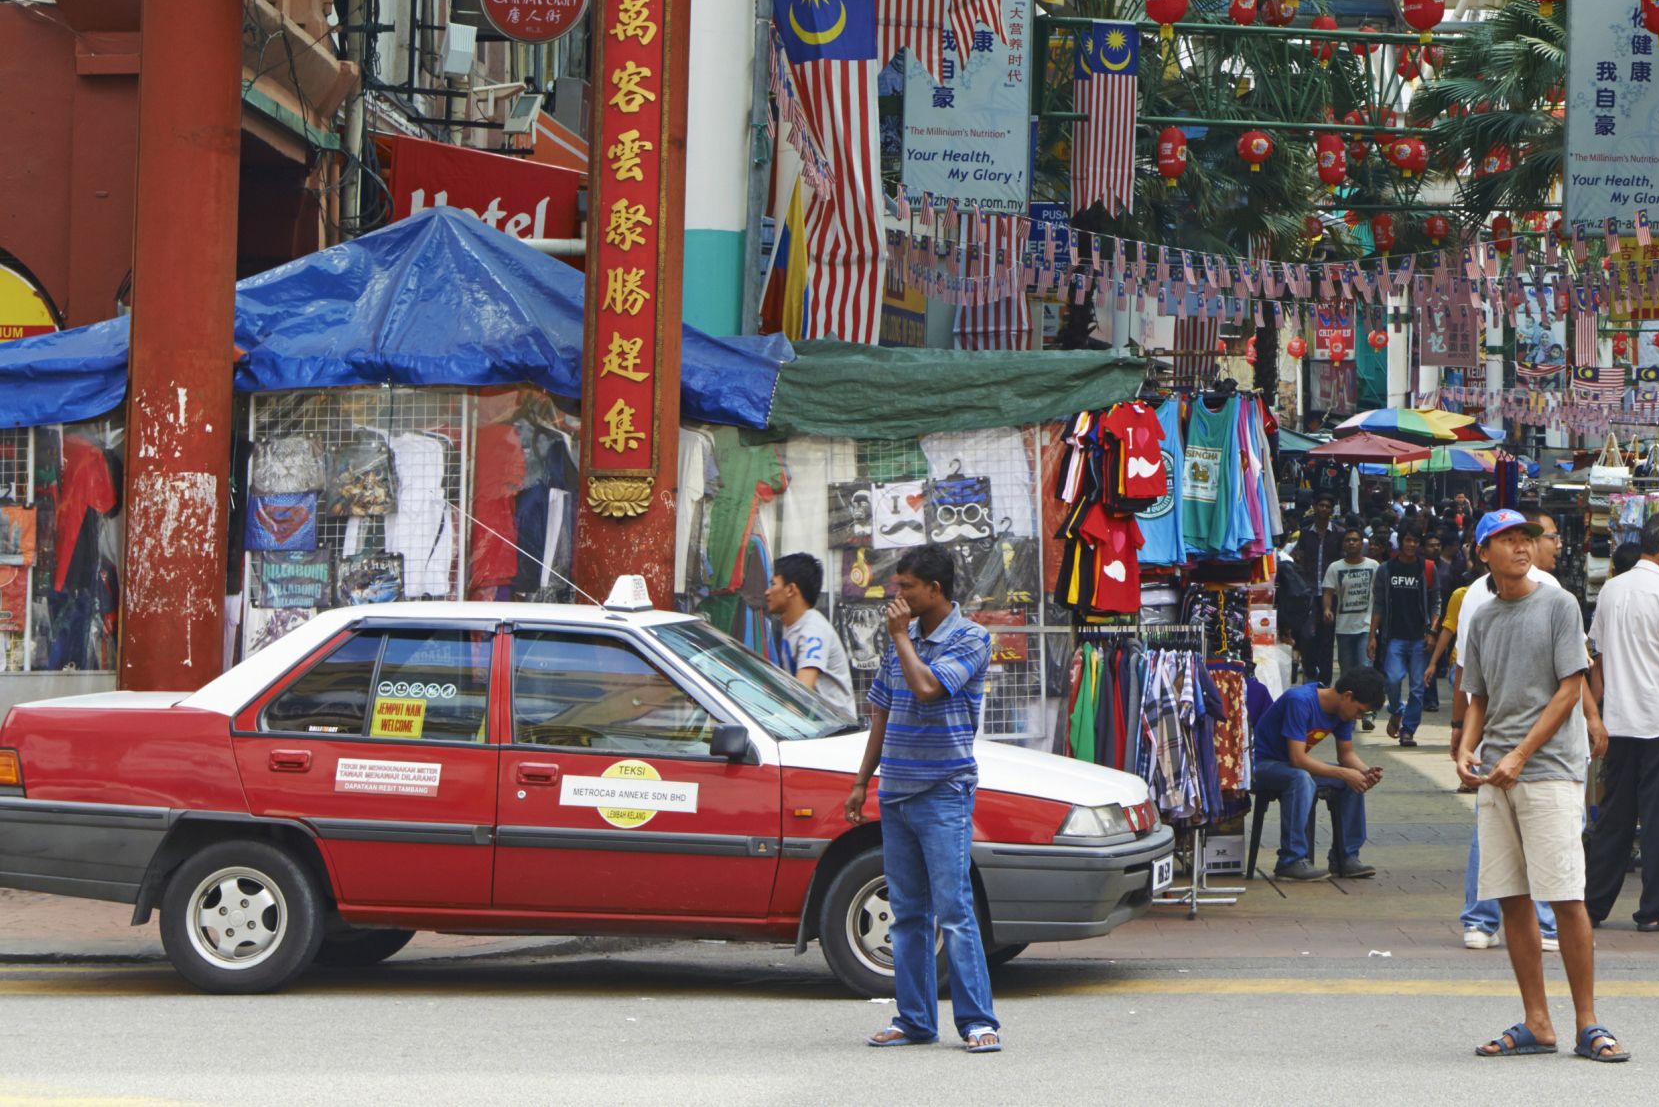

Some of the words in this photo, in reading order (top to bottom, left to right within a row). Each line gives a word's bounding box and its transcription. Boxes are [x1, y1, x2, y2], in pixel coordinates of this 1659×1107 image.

[1595, 61, 1617, 136] 我自豪
[910, 126, 924, 135] The
[970, 129, 1006, 139] Nutrition
[907, 149, 938, 161] Your
[942, 150, 994, 165] Health,
[948, 168, 968, 182] My
[973, 169, 1012, 184] Glory
[1572, 174, 1600, 186] Your
[1605, 175, 1654, 189] Health,
[1610, 192, 1629, 204] My
[1042, 210, 1068, 220] PUSA
[0, 327, 24, 338] UM
[1184, 448, 1218, 461] SINGHA
[1391, 576, 1415, 586] GFW
[806, 637, 822, 659] 2
[377, 702, 404, 715] JEMPUT
[406, 704, 422, 717] NAIK
[380, 718, 414, 733] WELCOME
[340, 770, 363, 779] TAWAR
[365, 772, 400, 780] MENAWAR
[401, 774, 437, 782] DILARANG
[619, 766, 645, 776] TEKSI
[345, 782, 377, 791] DAPATKAN
[398, 785, 428, 794] TAMBANG
[573, 788, 616, 798] METROCAB
[619, 790, 649, 800] ANNEXE
[652, 792, 667, 801] SDN
[670, 793, 686, 802] BHD
[627, 811, 646, 820] KELANG
